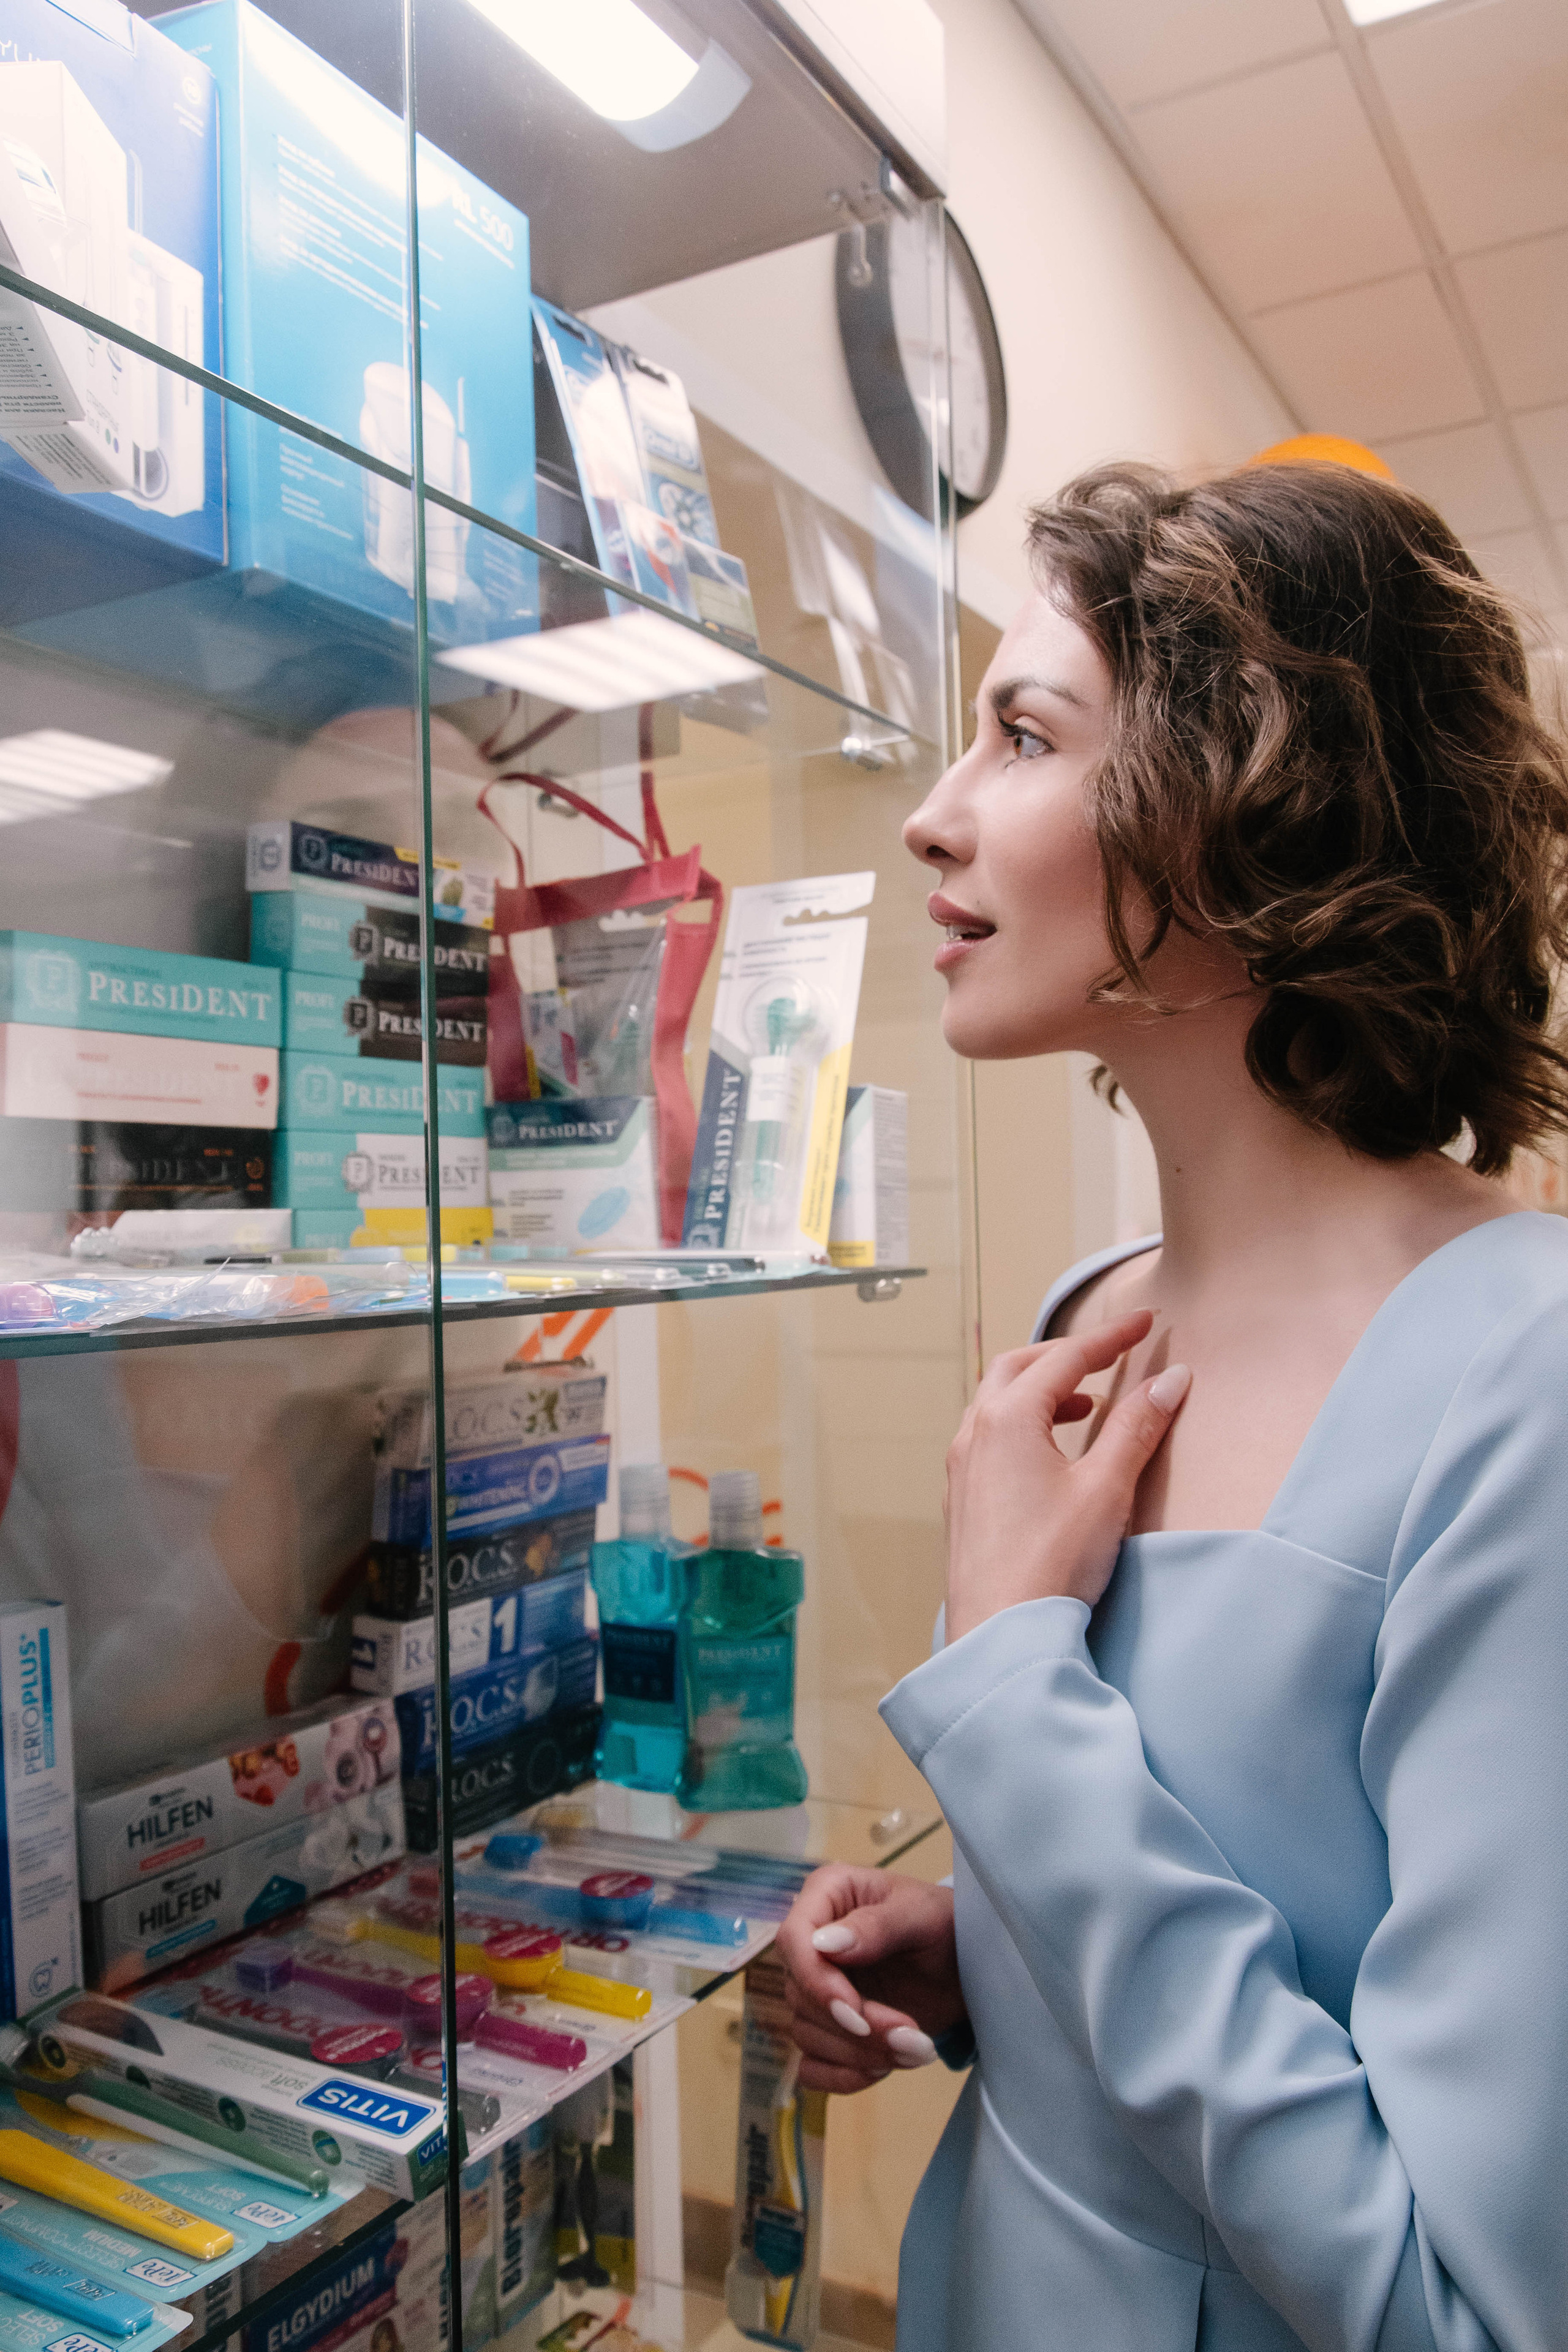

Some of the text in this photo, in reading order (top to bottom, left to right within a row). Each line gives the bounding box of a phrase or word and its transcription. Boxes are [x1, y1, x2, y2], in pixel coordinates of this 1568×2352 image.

[480, 205, 514, 251] 500
[331, 853, 421, 888] PRESIDEN
[384, 937, 487, 973] PREDENT
[89, 970, 272, 1021] PRESIDENT
[378, 1012, 484, 1042] PRESDENT
[342, 1080, 477, 1114] PRESIDNT
[519, 1119, 620, 1140] PRESIDENT
[704, 1069, 742, 1219] PRESIDENT
[377, 1164, 482, 1185] PRESENT
[493, 1596, 518, 1653] 1
[126, 1796, 214, 1849] HILFEN
[138, 1878, 222, 1936] HILFEN
[317, 2088, 410, 2128] VITIS
[420, 2136, 445, 2161] VIT
[83, 2228, 142, 2258] MEDIUM
[17, 2309, 64, 2333] SOFT
[267, 2256, 377, 2352] ELGYDIUM
